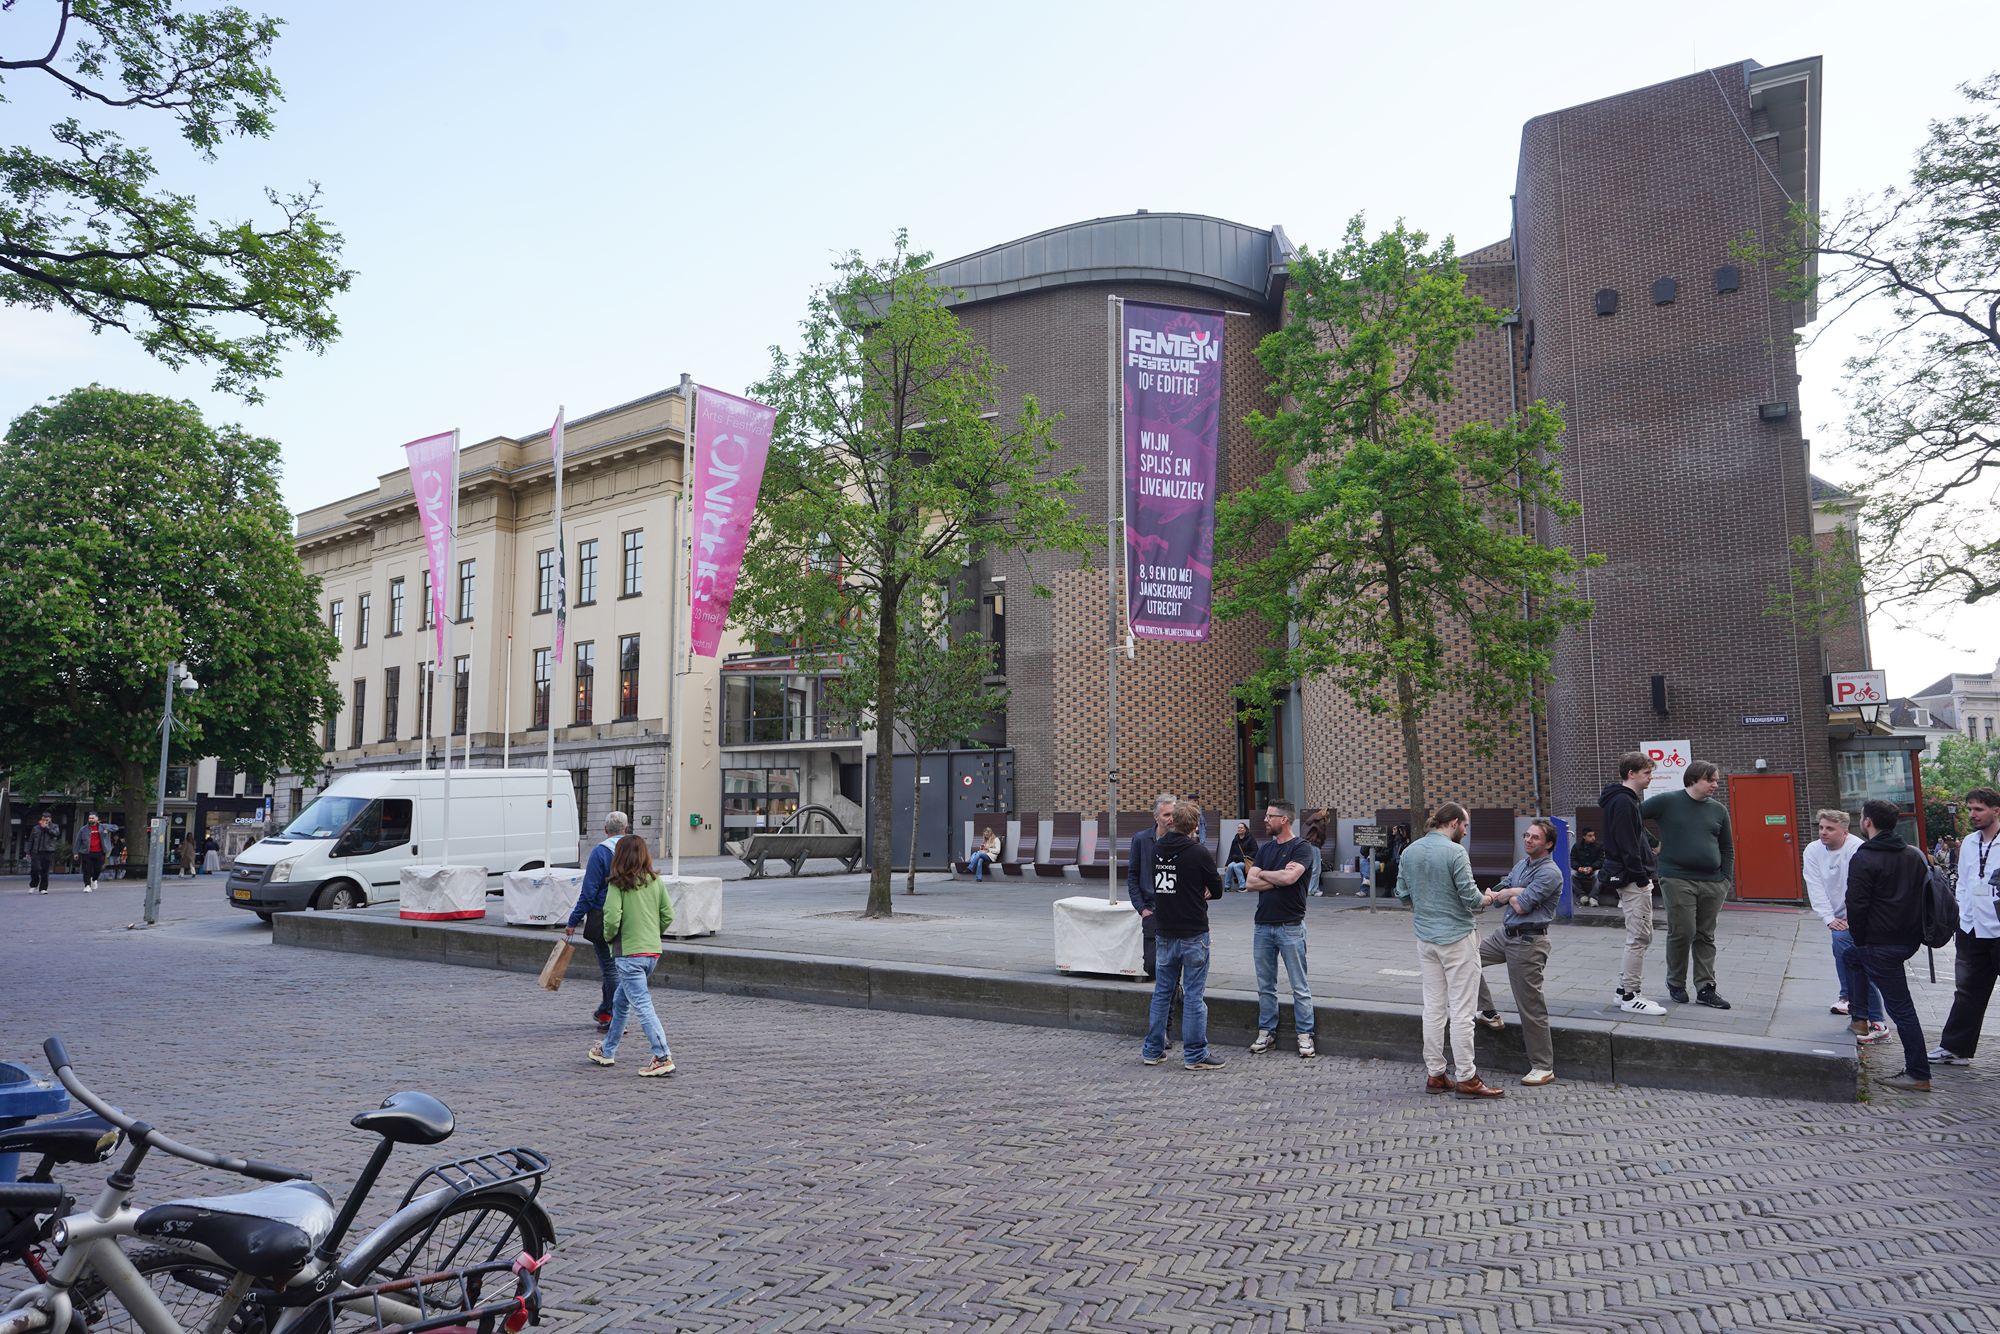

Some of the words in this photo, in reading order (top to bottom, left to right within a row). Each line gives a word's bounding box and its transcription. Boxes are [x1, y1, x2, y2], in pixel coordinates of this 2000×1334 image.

[1128, 328, 1219, 363] FONTEYN
[1128, 352, 1200, 374] FESTIVAL
[1156, 374, 1199, 397] EDITIE!
[702, 407, 723, 424] Arts
[1140, 431, 1174, 456] WIJN,
[1140, 454, 1171, 475] SPIJS
[1175, 458, 1191, 477] EN
[1140, 476, 1205, 500] LIVEMUZIEK
[1139, 564, 1147, 580] 8,
[1149, 565, 1154, 580] 9
[1155, 566, 1166, 581] EN
[1167, 567, 1176, 582] 10
[1178, 568, 1193, 583] MEI
[1139, 582, 1193, 600] JANSKERKHOF
[702, 611, 720, 624] mei
[1147, 600, 1182, 616] UTRECHT
[1837, 682, 1856, 702] P
[1745, 716, 1785, 724] STADHUISPLEIN
